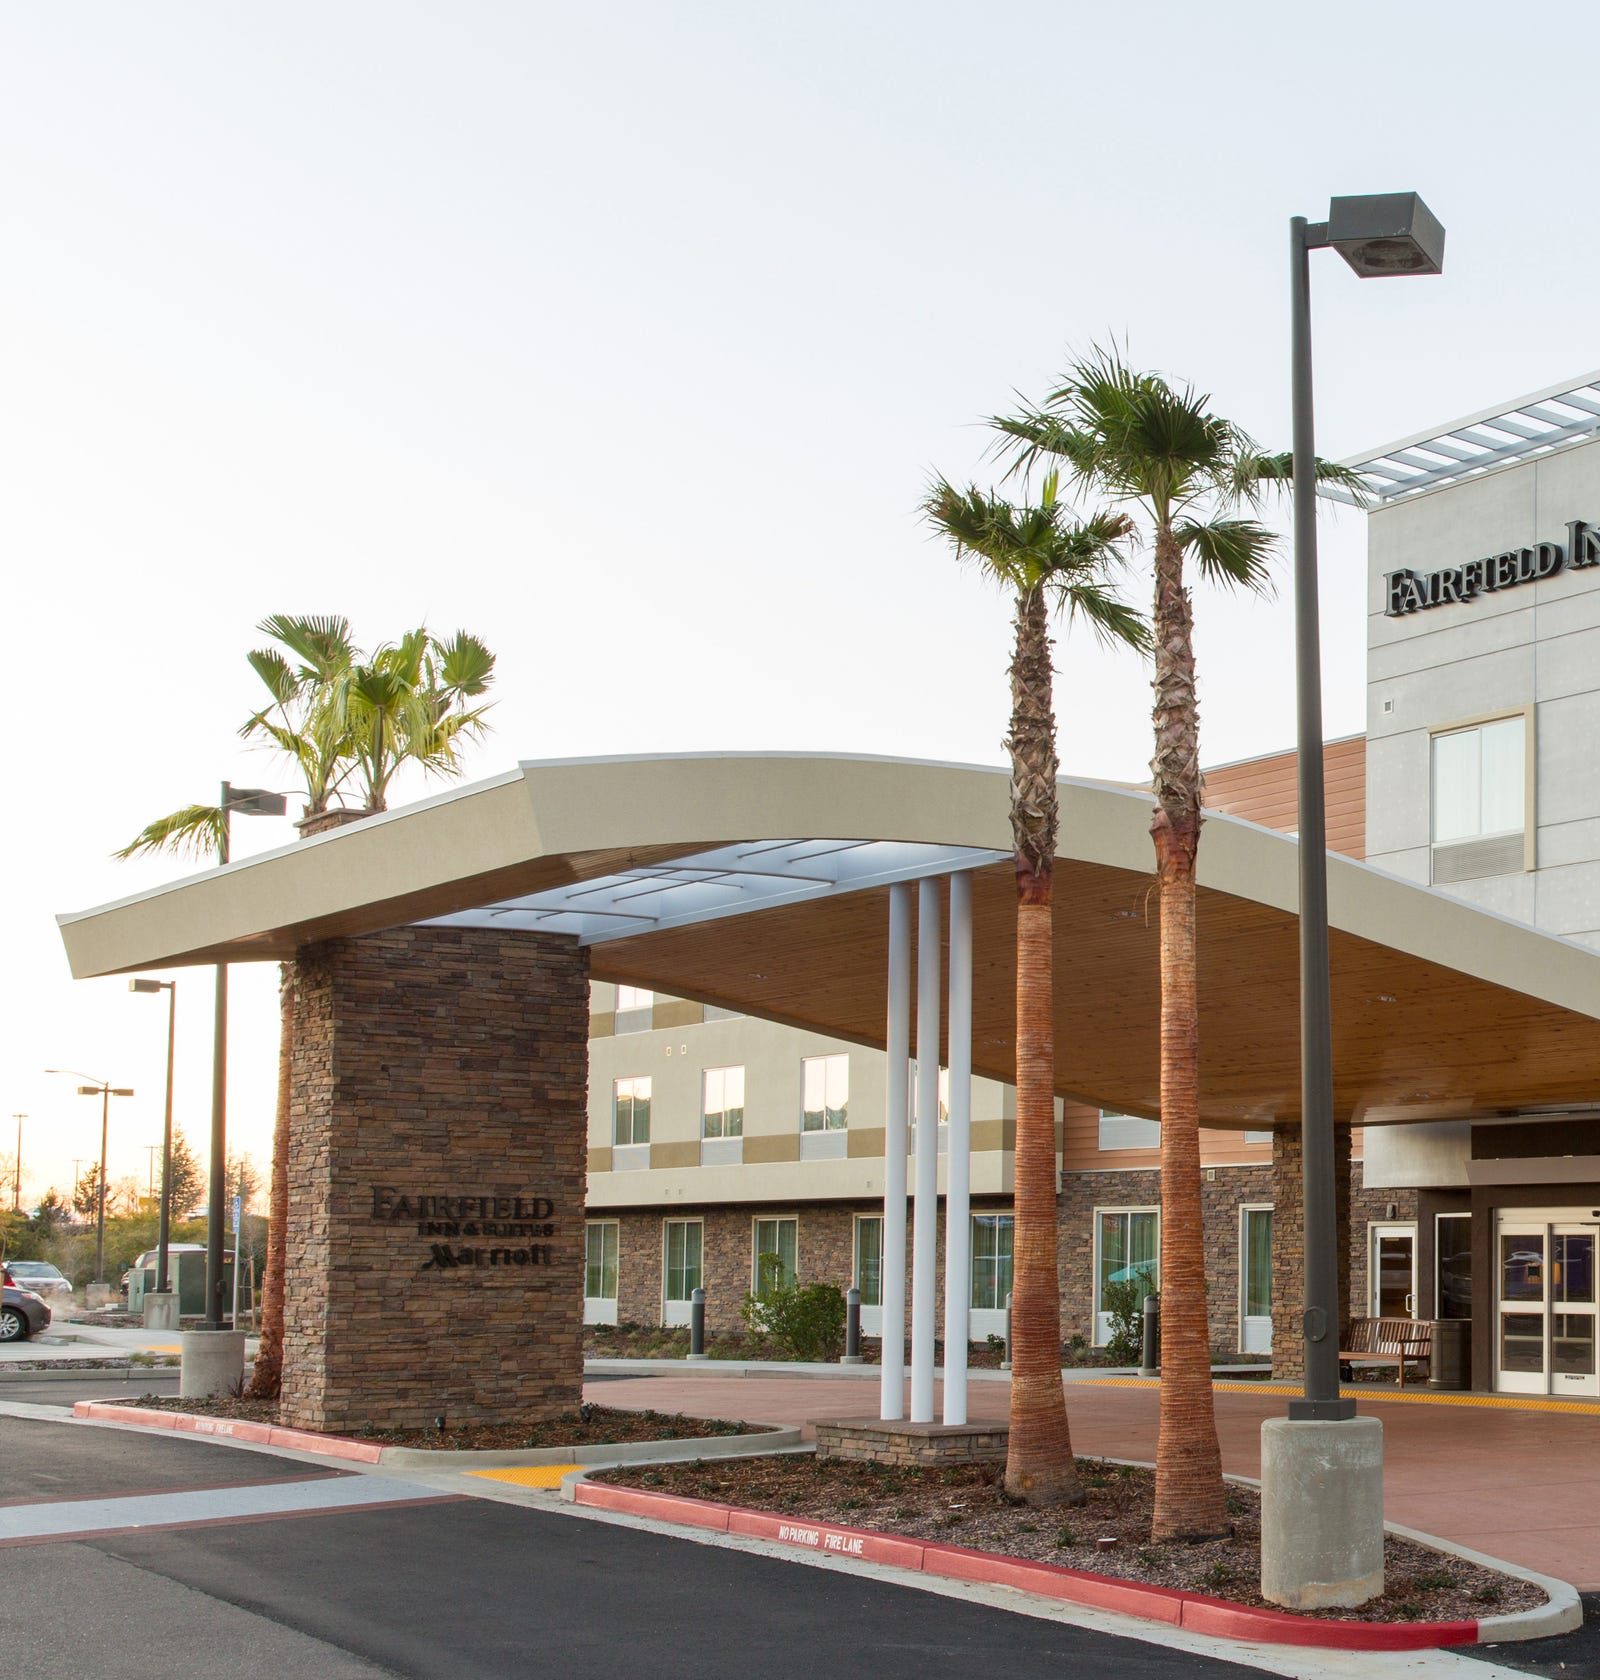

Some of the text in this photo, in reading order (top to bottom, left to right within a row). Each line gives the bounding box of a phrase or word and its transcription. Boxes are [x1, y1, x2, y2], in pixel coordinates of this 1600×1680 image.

[1383, 541, 1564, 617] FAIRFIELD
[371, 1186, 554, 1219] FAIRFIELD
[418, 1222, 554, 1237] INN & SUITES
[422, 1243, 552, 1269] Marriott
[778, 1525, 864, 1554] NO PARKING FIRE LANE
